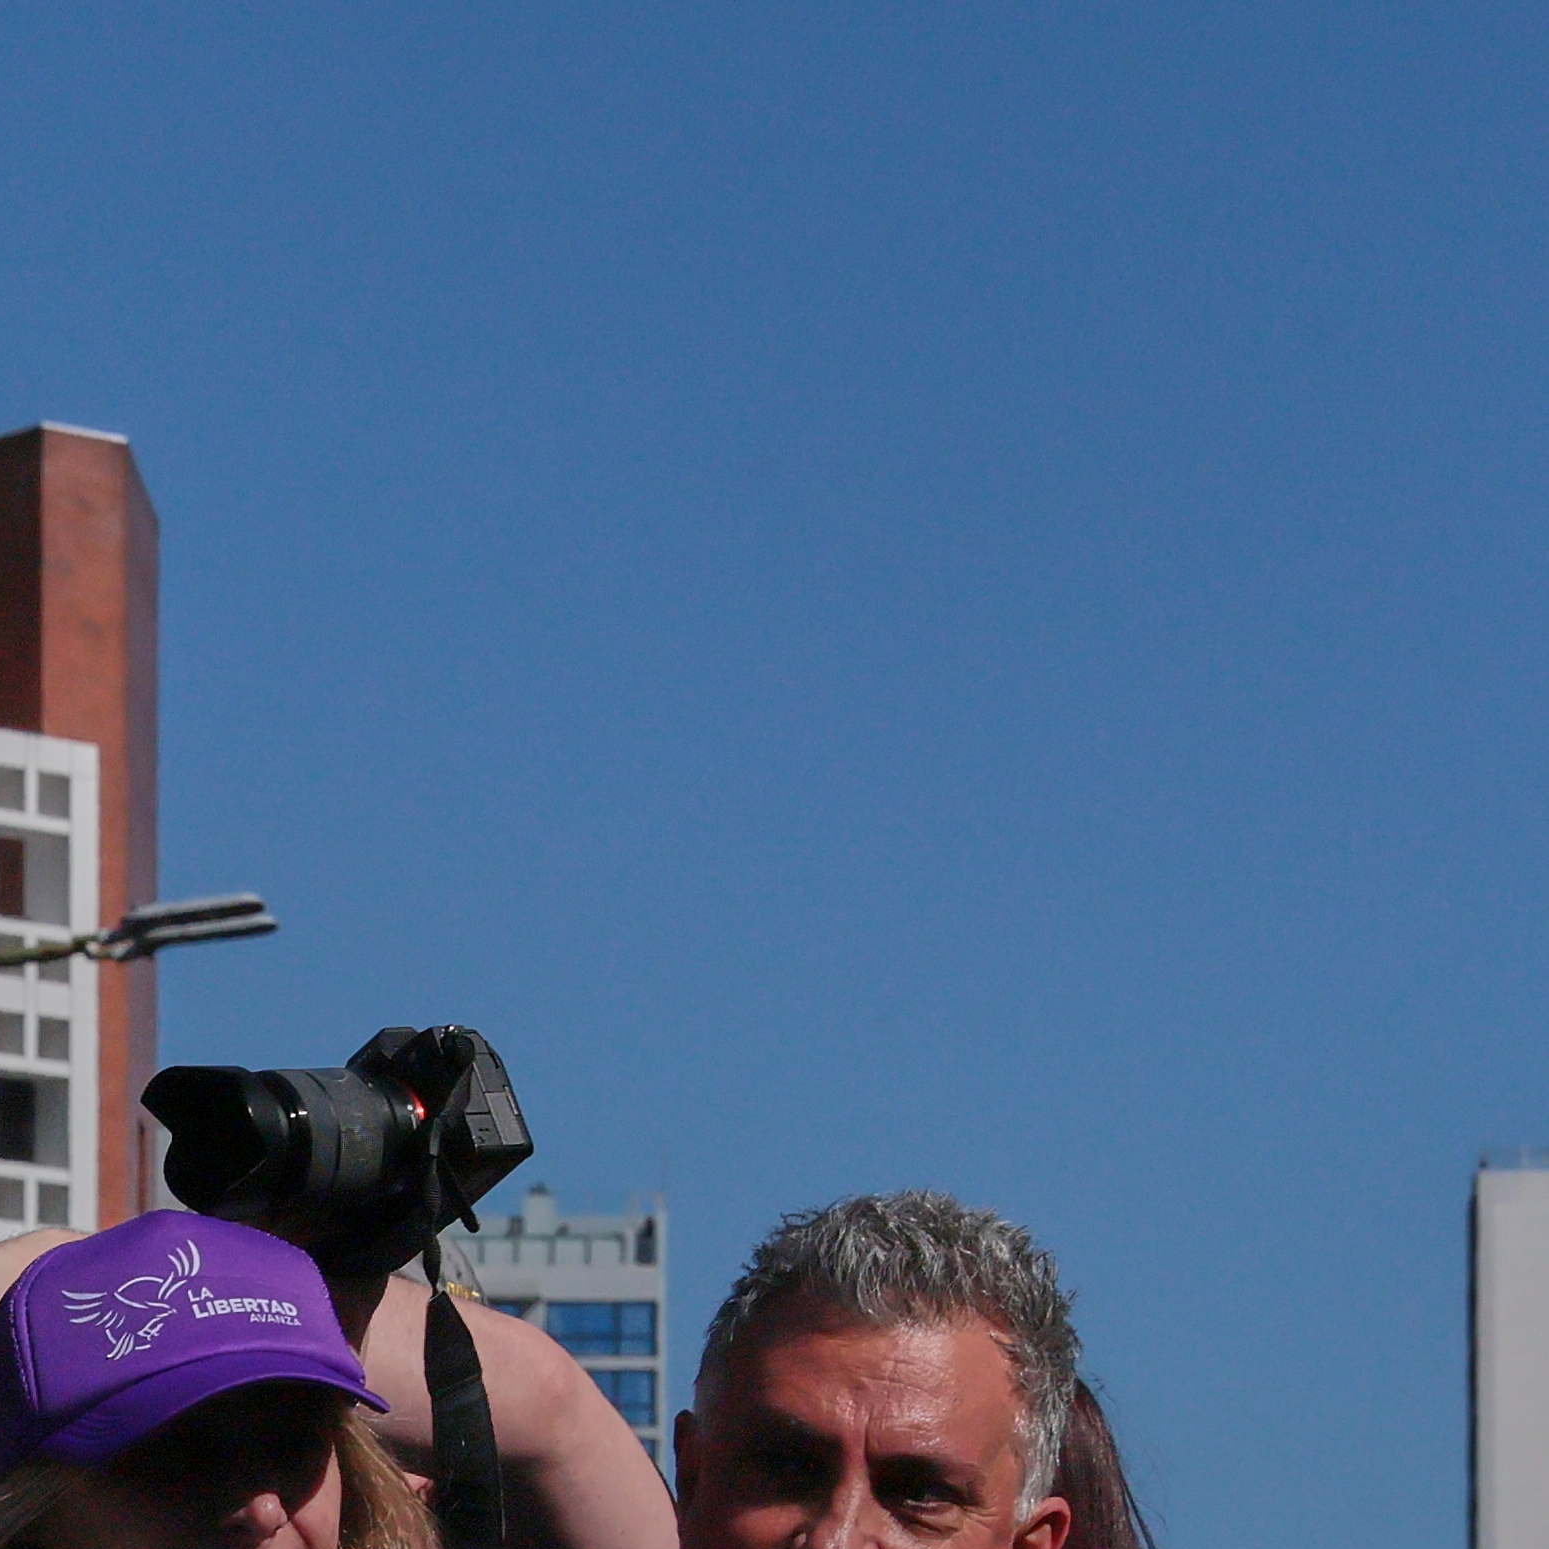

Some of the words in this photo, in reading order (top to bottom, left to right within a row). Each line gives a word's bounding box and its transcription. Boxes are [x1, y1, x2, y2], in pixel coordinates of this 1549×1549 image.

[187, 1286, 214, 1302] LA
[193, 1298, 298, 1318] LIBERTAD
[250, 1313, 302, 1326] AVANZA
